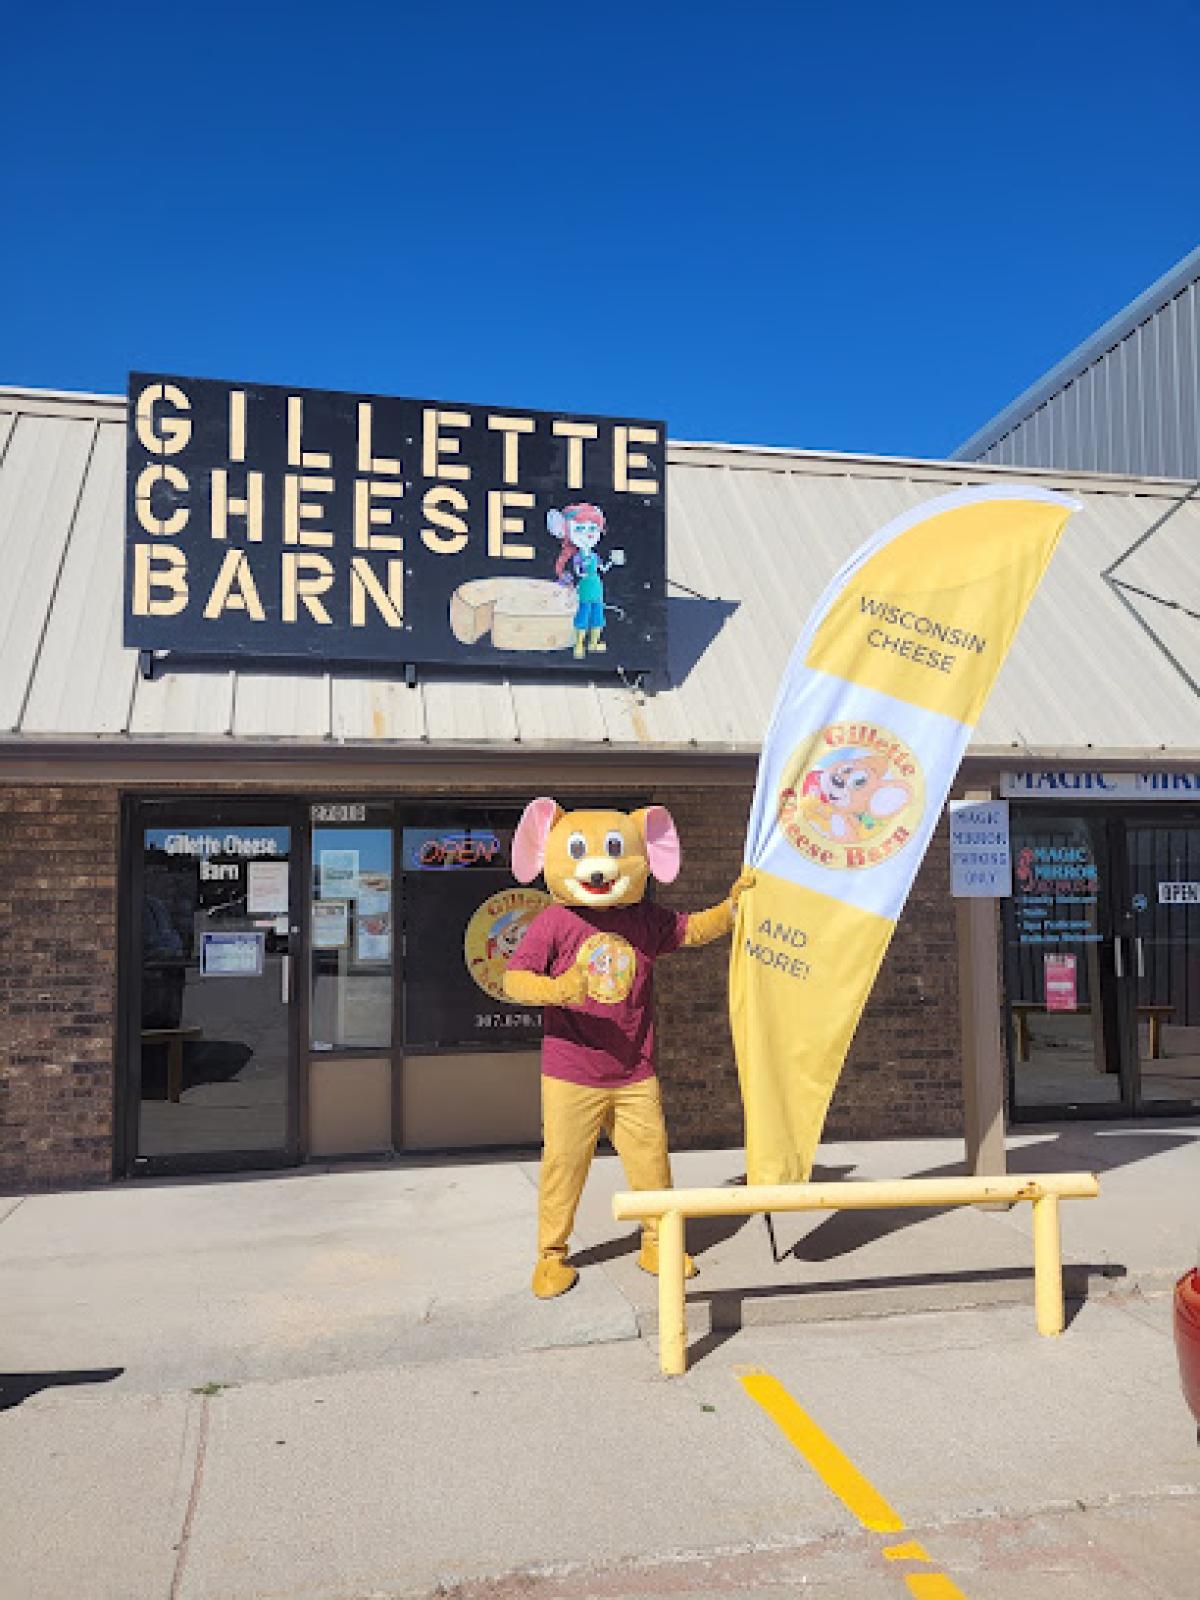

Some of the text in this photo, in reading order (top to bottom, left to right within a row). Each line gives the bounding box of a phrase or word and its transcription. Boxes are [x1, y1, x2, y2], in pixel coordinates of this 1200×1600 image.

[135, 383, 659, 494] GILLETTE
[134, 462, 536, 560] CHEESE
[131, 543, 405, 628] BARN
[859, 597, 986, 655] WISCONSIN
[866, 629, 957, 674] CHEESE
[823, 723, 916, 777] Gillette
[164, 834, 277, 855] Gillette Cheese
[420, 840, 498, 864] OPEN
[845, 826, 910, 868] Barn
[200, 862, 239, 880] Barn
[1161, 884, 1198, 901] OPEN
[757, 918, 808, 949] AND
[745, 938, 810, 979] MORE!
